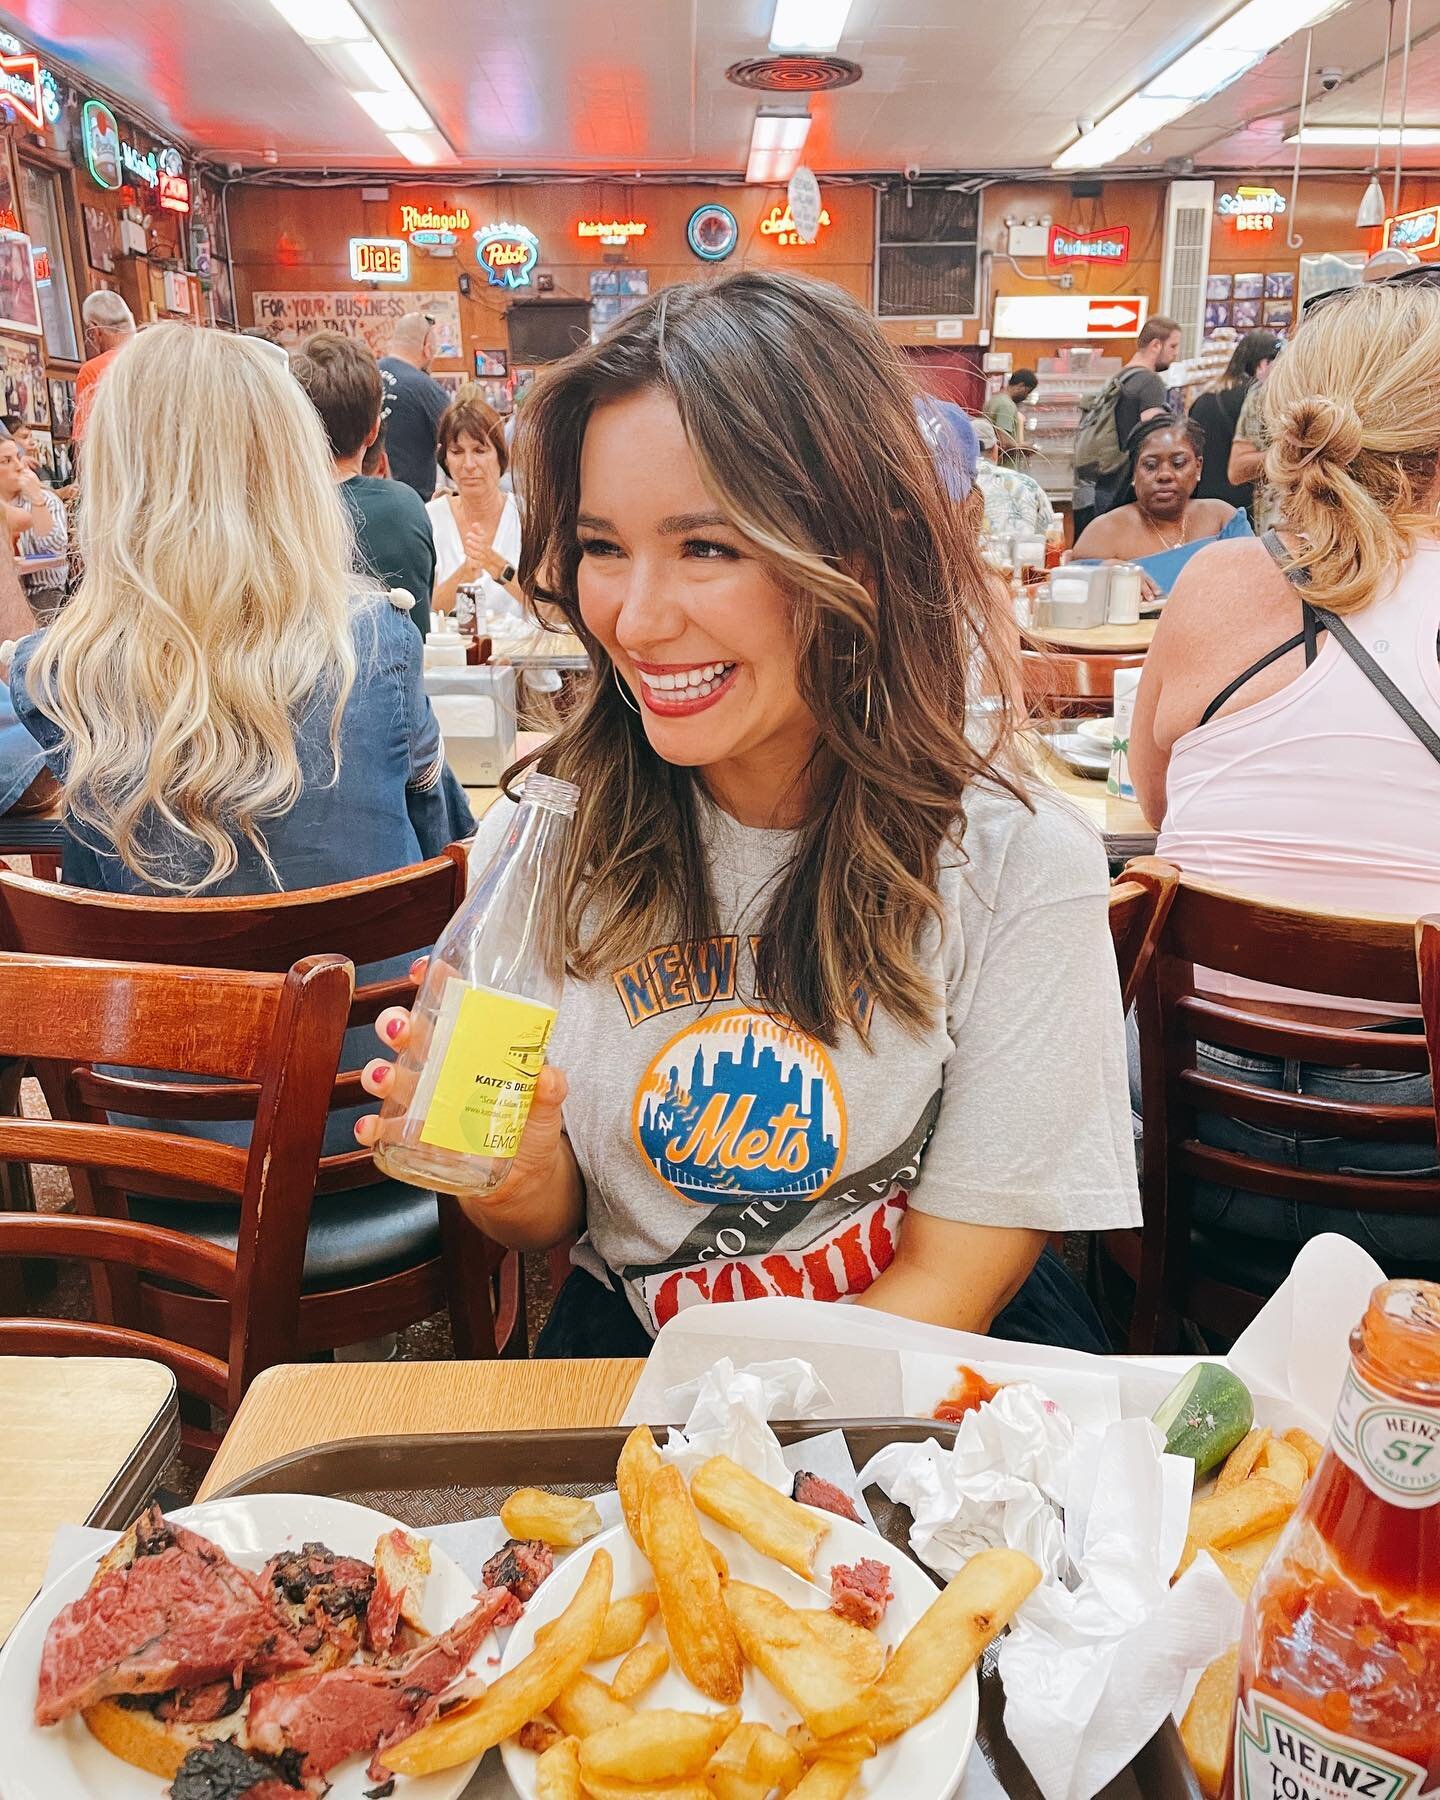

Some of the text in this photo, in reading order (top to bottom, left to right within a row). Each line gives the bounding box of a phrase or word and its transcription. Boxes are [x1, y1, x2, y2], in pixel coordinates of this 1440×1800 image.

[401, 205, 470, 232] Rheingold
[1236, 214, 1274, 231] BEER
[261, 299, 405, 317] FOR YOUR BUSINESS
[612, 934, 738, 1028] NEW
[475, 1074, 513, 1091] KATZ'S
[666, 1093, 811, 1173] Mets
[1386, 1417, 1440, 1441] HEINZ
[1383, 1439, 1434, 1467] 57
[1374, 1456, 1437, 1486] VARIETIES
[1275, 1727, 1386, 1798] HEINZ
